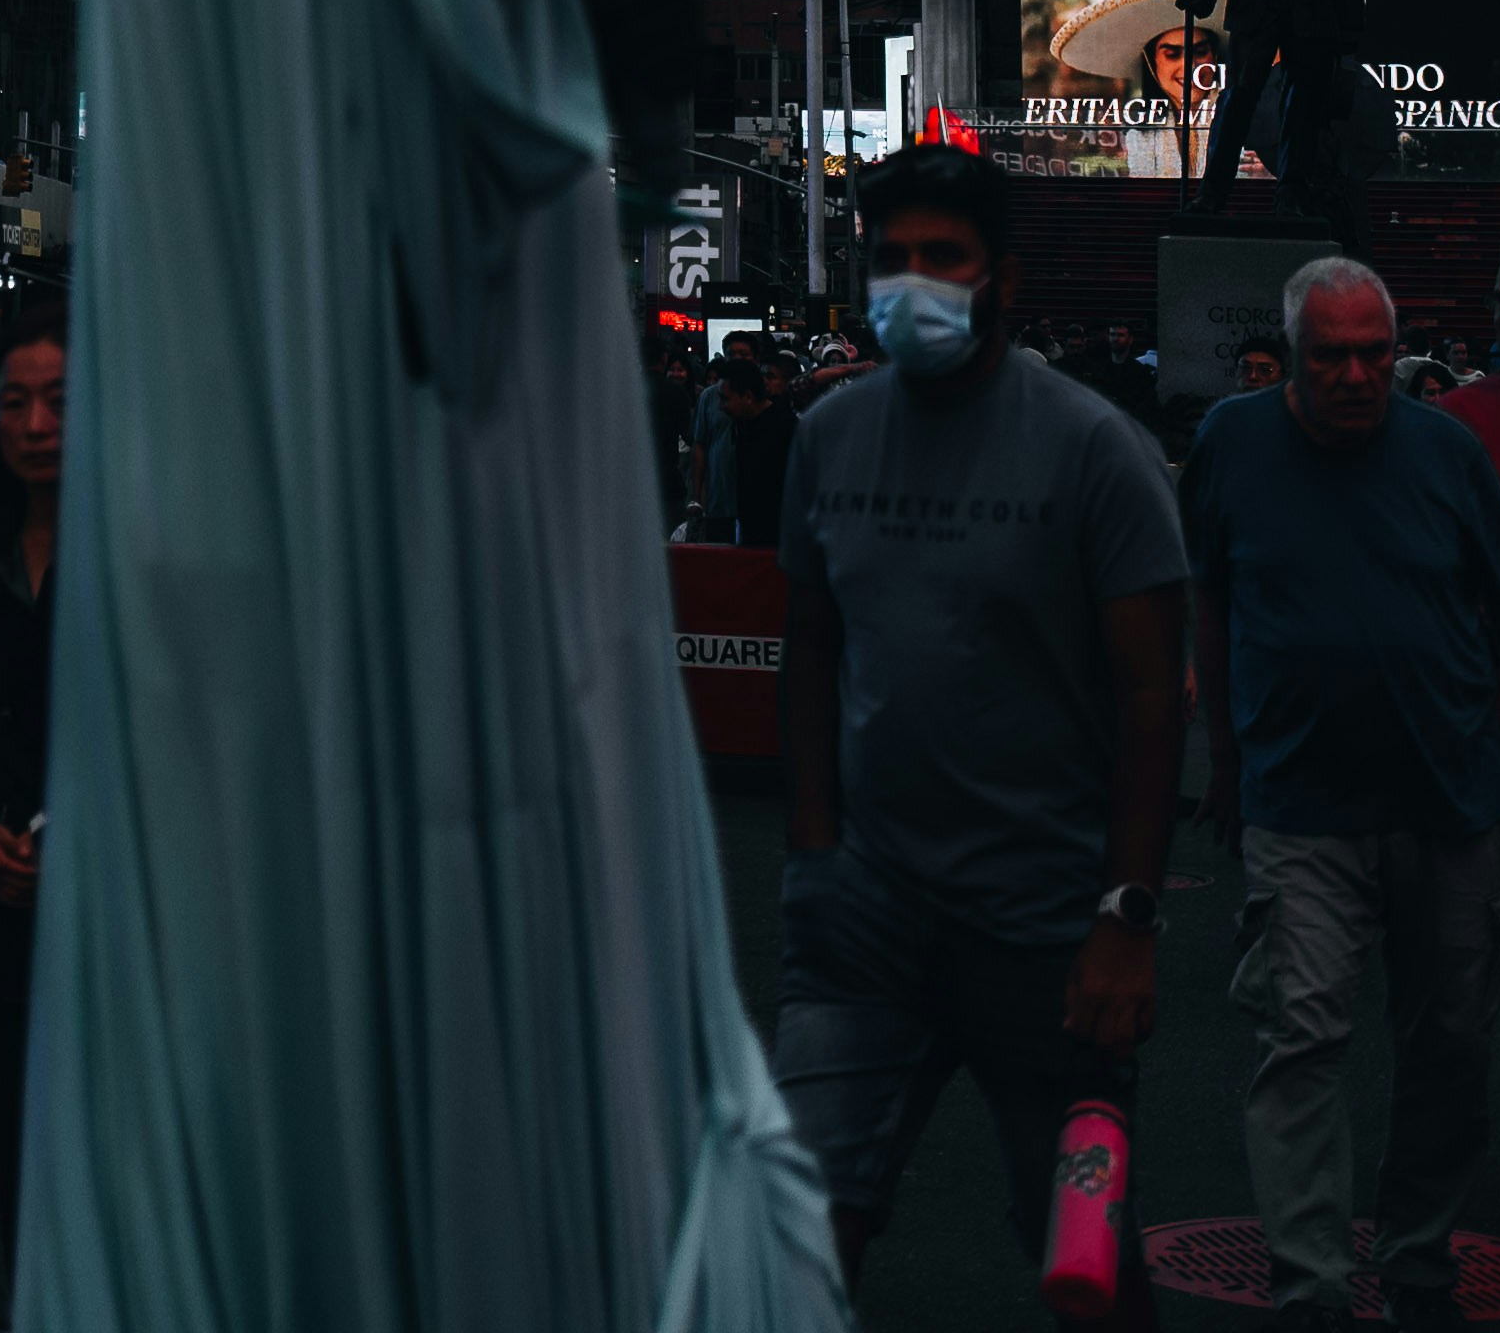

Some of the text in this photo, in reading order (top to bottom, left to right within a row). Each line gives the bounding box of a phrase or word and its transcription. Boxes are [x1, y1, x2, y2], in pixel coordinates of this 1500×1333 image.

[1021, 96, 1169, 128] ERITAGE
[2, 223, 21, 246] TICKET
[21, 226, 41, 248] CENTER
[969, 499, 1054, 526] COLE
[675, 636, 781, 667] QUARE
